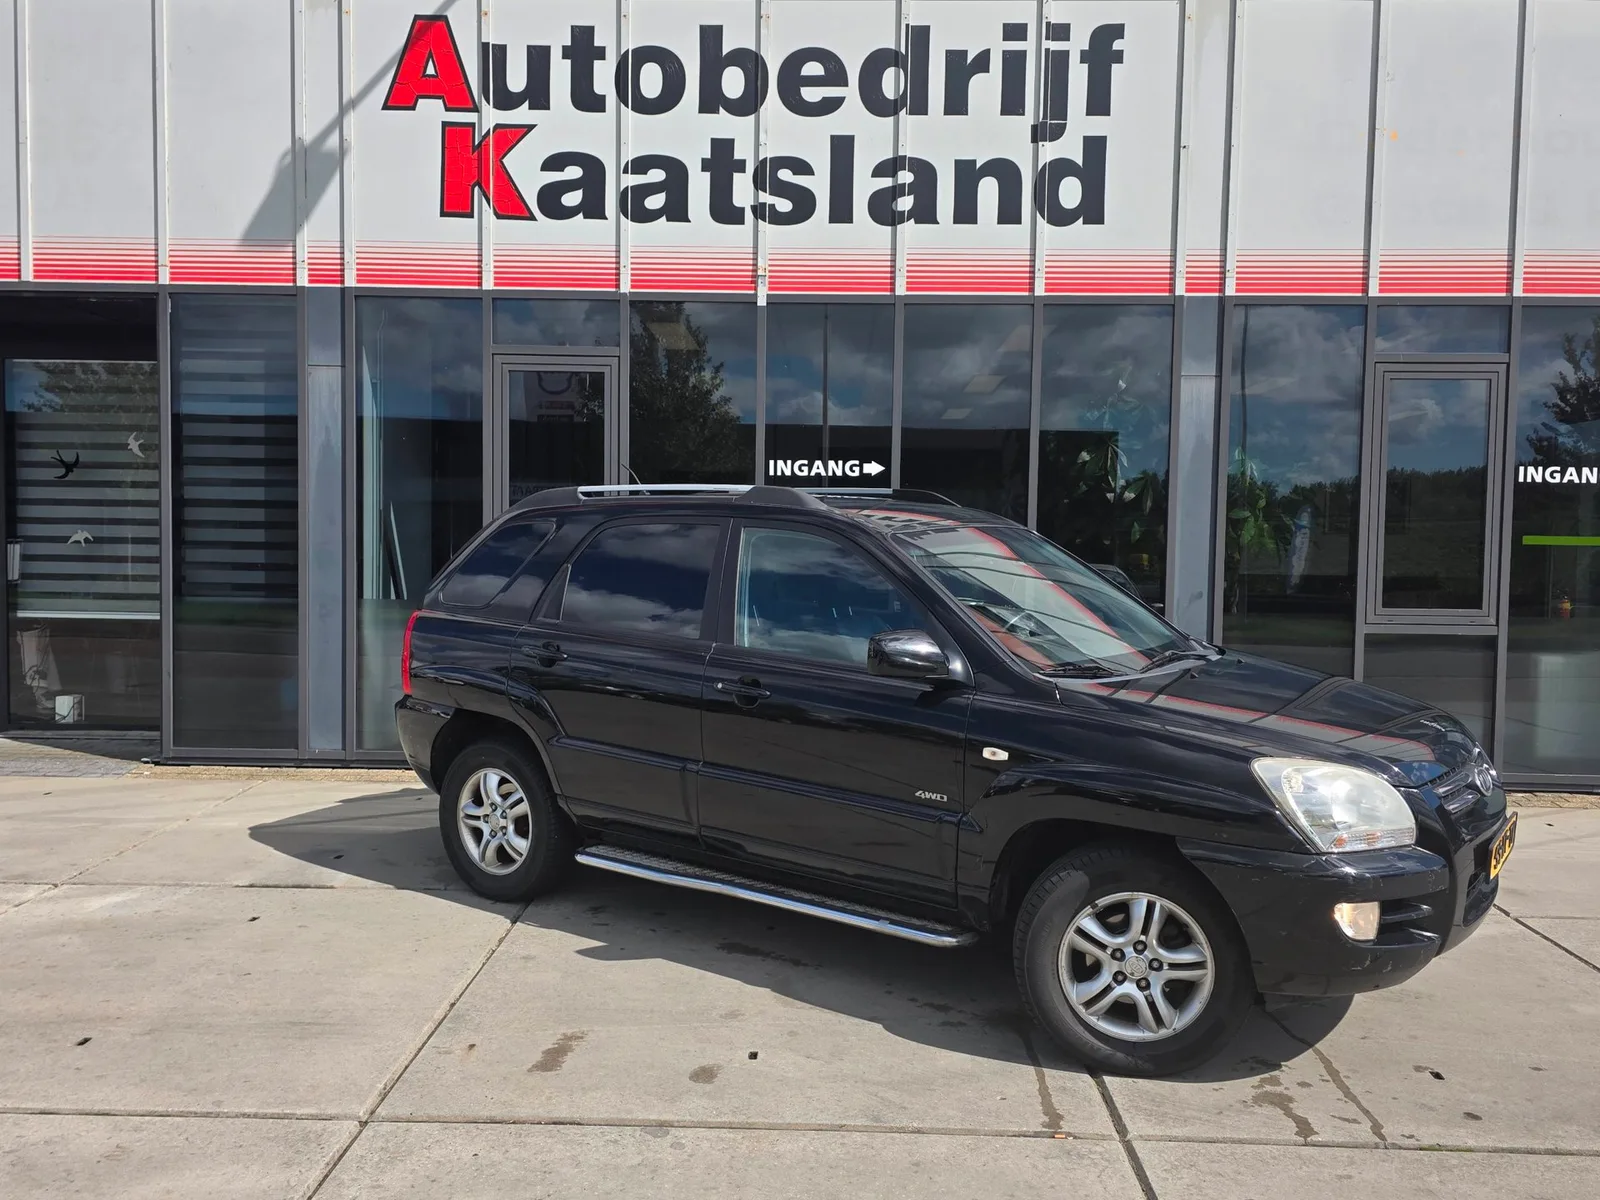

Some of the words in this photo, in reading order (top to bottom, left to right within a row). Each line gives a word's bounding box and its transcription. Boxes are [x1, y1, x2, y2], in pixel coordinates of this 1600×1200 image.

[381, 14, 1125, 143] Autobedrijf
[440, 121, 1107, 227] Kaatsland
[768, 459, 860, 477] INGANG
[1518, 466, 1600, 484] INGAN
[915, 790, 947, 802] 4WD
